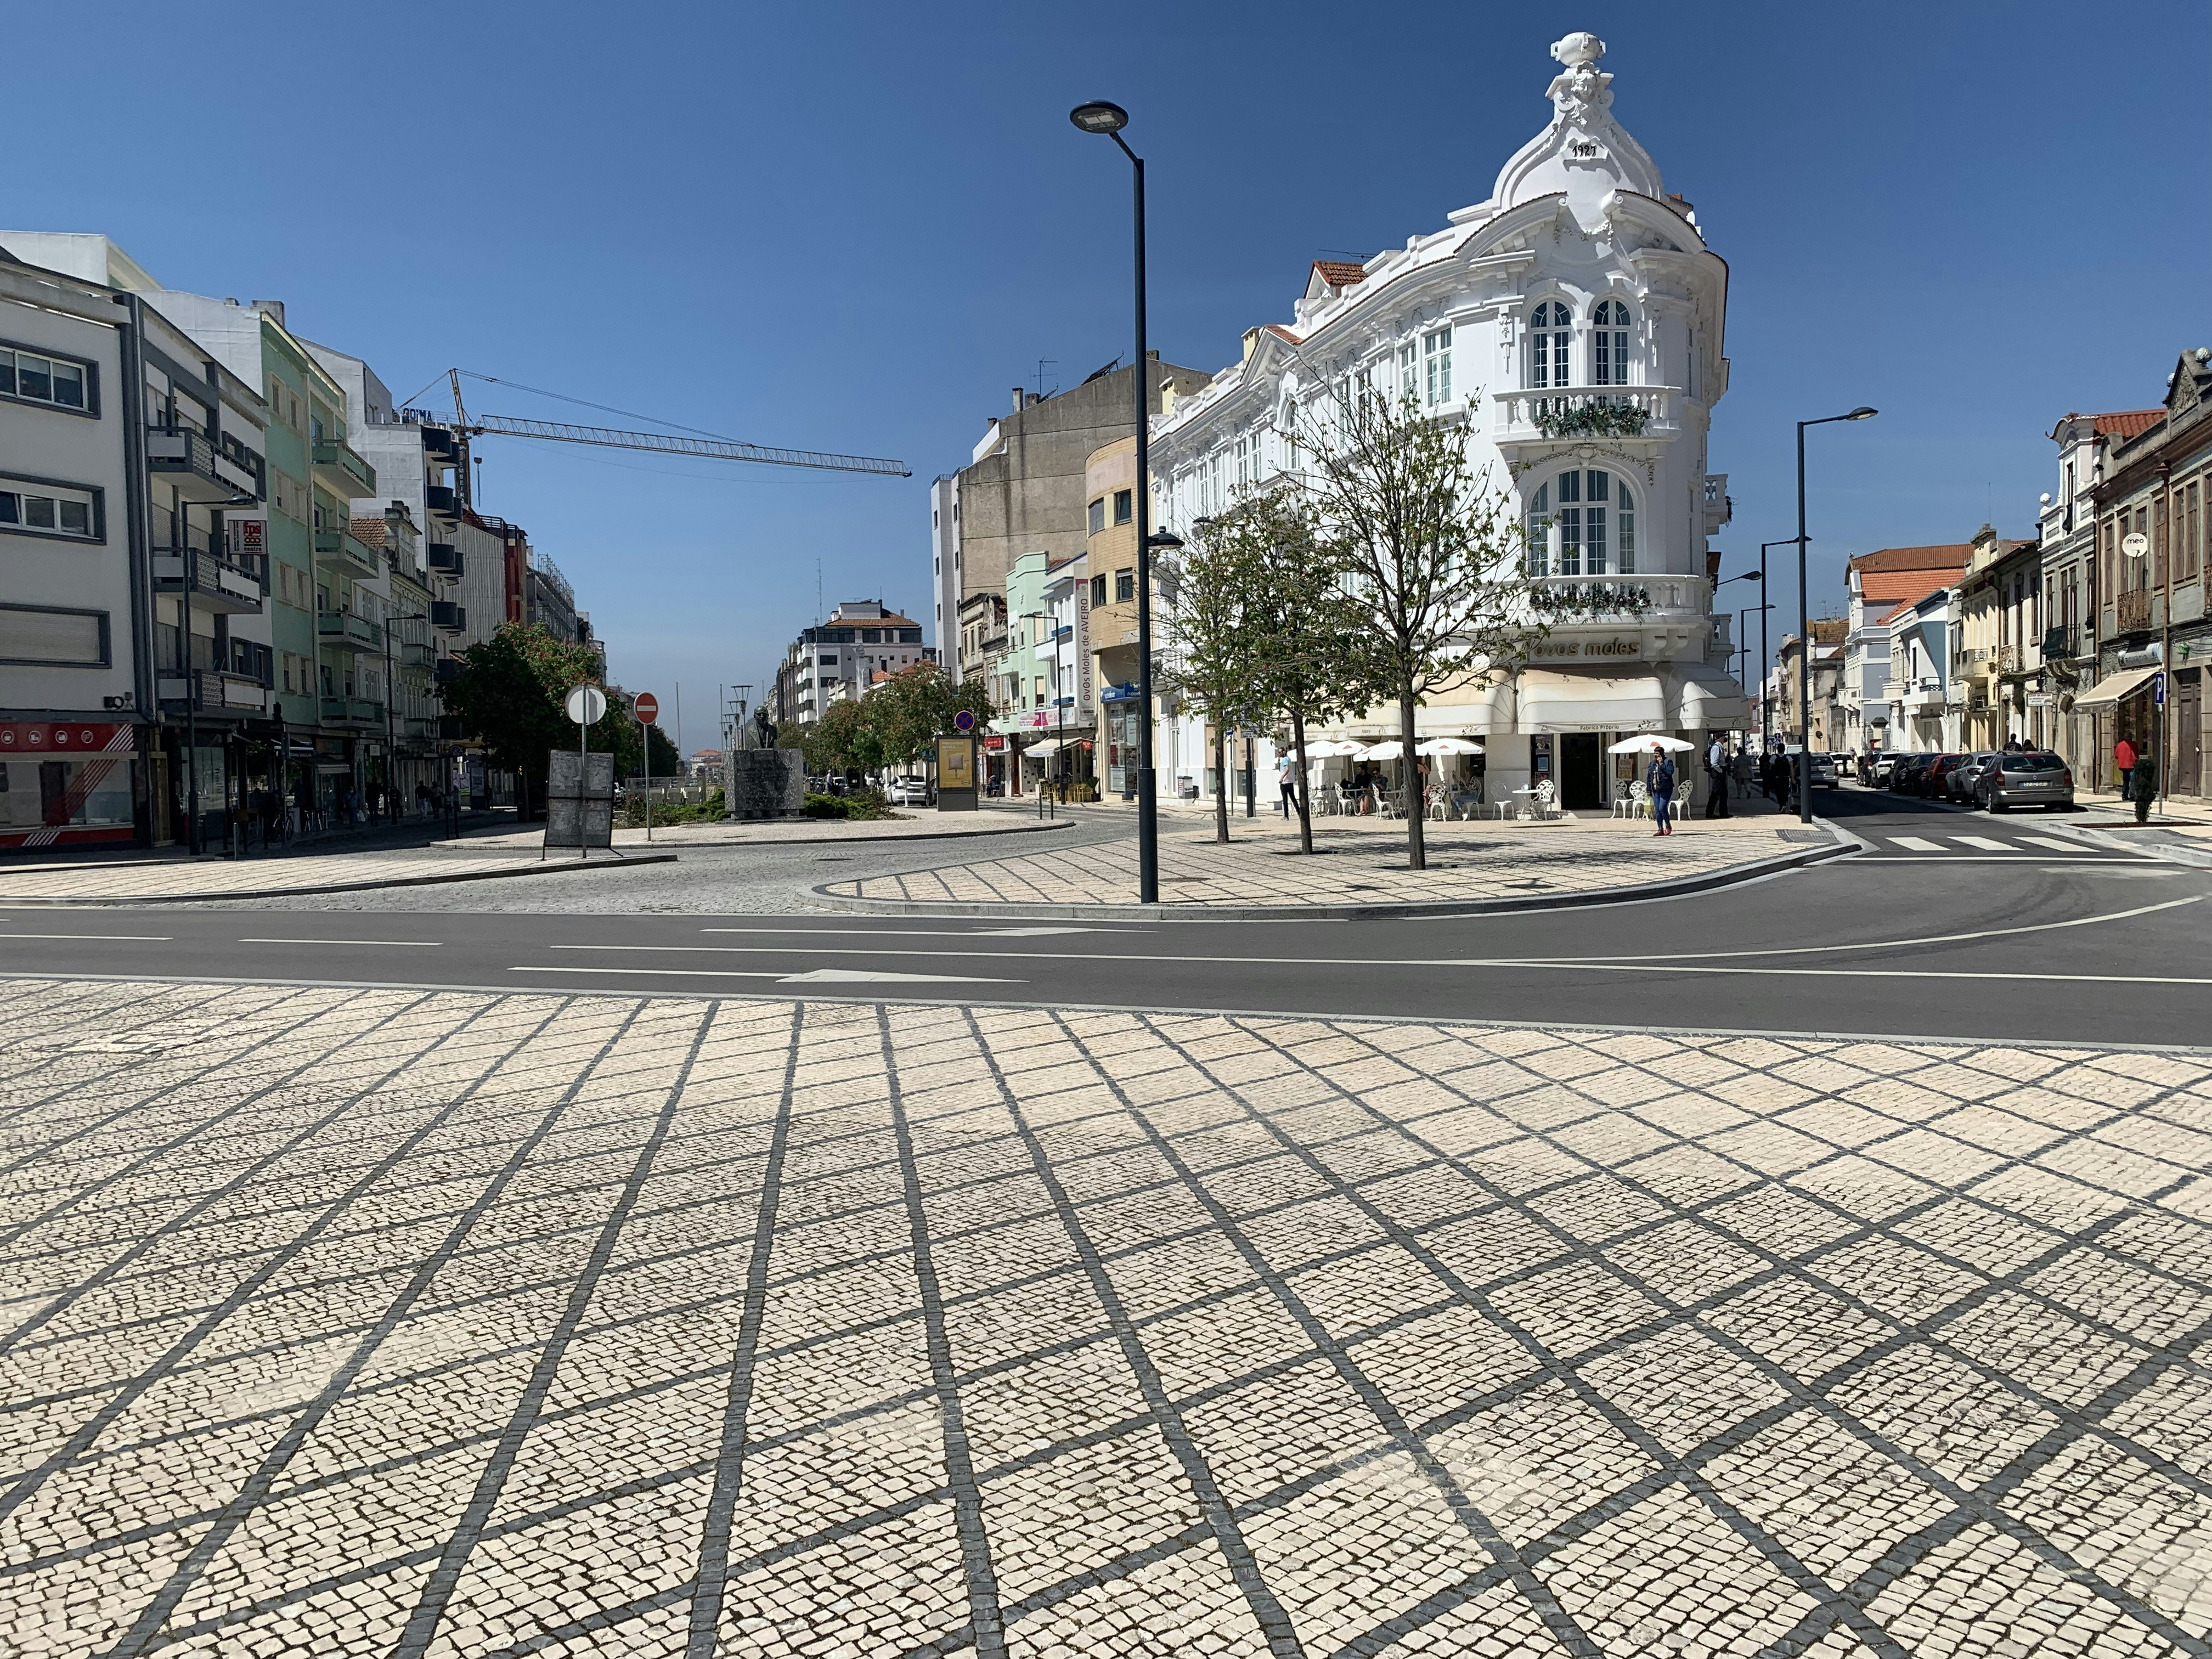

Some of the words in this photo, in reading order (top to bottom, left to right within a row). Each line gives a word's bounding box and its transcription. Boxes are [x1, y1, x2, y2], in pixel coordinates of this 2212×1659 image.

[1572, 145, 1596, 157] 1927
[1081, 635, 1089, 646] de
[1585, 637, 1640, 656] moles
[1082, 648, 1090, 675] Moles
[2157, 677, 2163, 701] P
